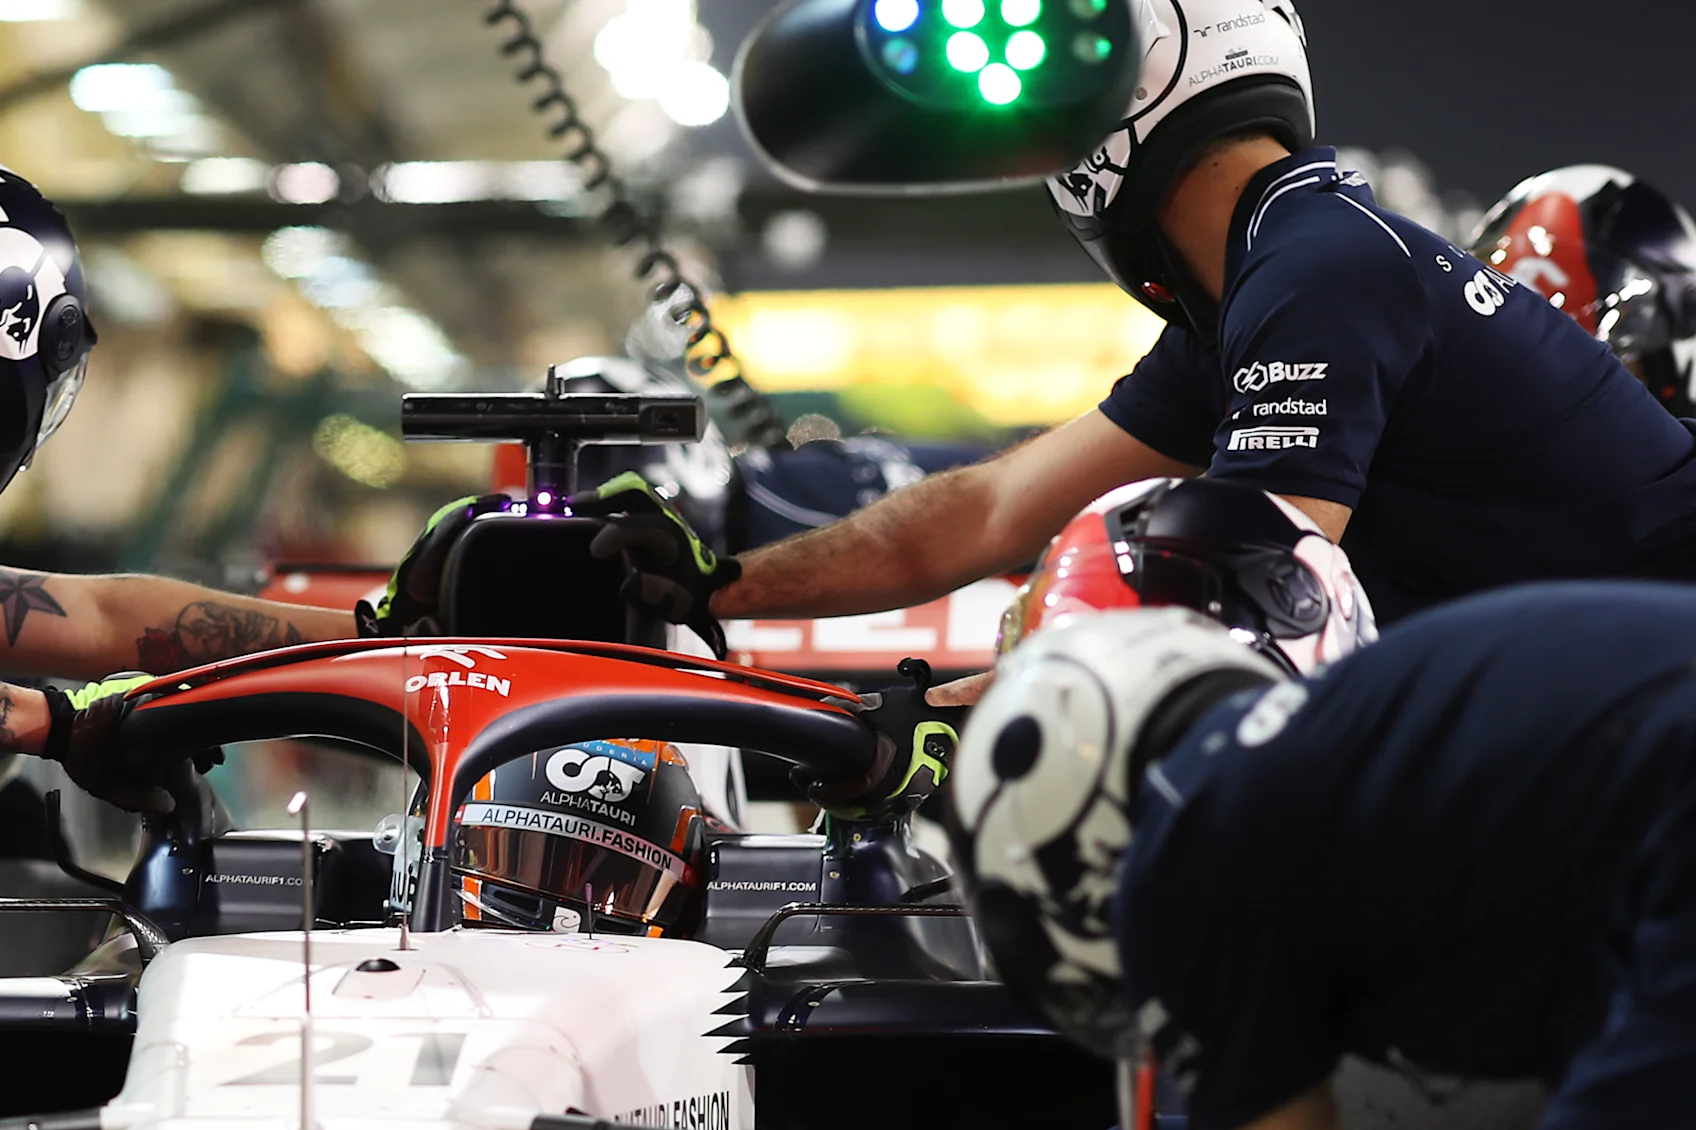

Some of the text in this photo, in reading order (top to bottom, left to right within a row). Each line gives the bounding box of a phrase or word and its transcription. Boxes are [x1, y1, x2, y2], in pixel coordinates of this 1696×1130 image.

[1216, 11, 1266, 33] randstad
[1188, 54, 1280, 87] ALPHATAURI.COM
[1253, 397, 1327, 416] randstad
[1227, 426, 1320, 450] PIRELLI
[405, 671, 511, 697] ORLEN
[582, 742, 647, 766] UDERIA
[540, 790, 637, 827] ALPHATAURI
[482, 807, 673, 871] ALPHATAURI.FASHION
[706, 881, 817, 892] ALPHATAURIF1.COM
[216, 1030, 469, 1087] 21
